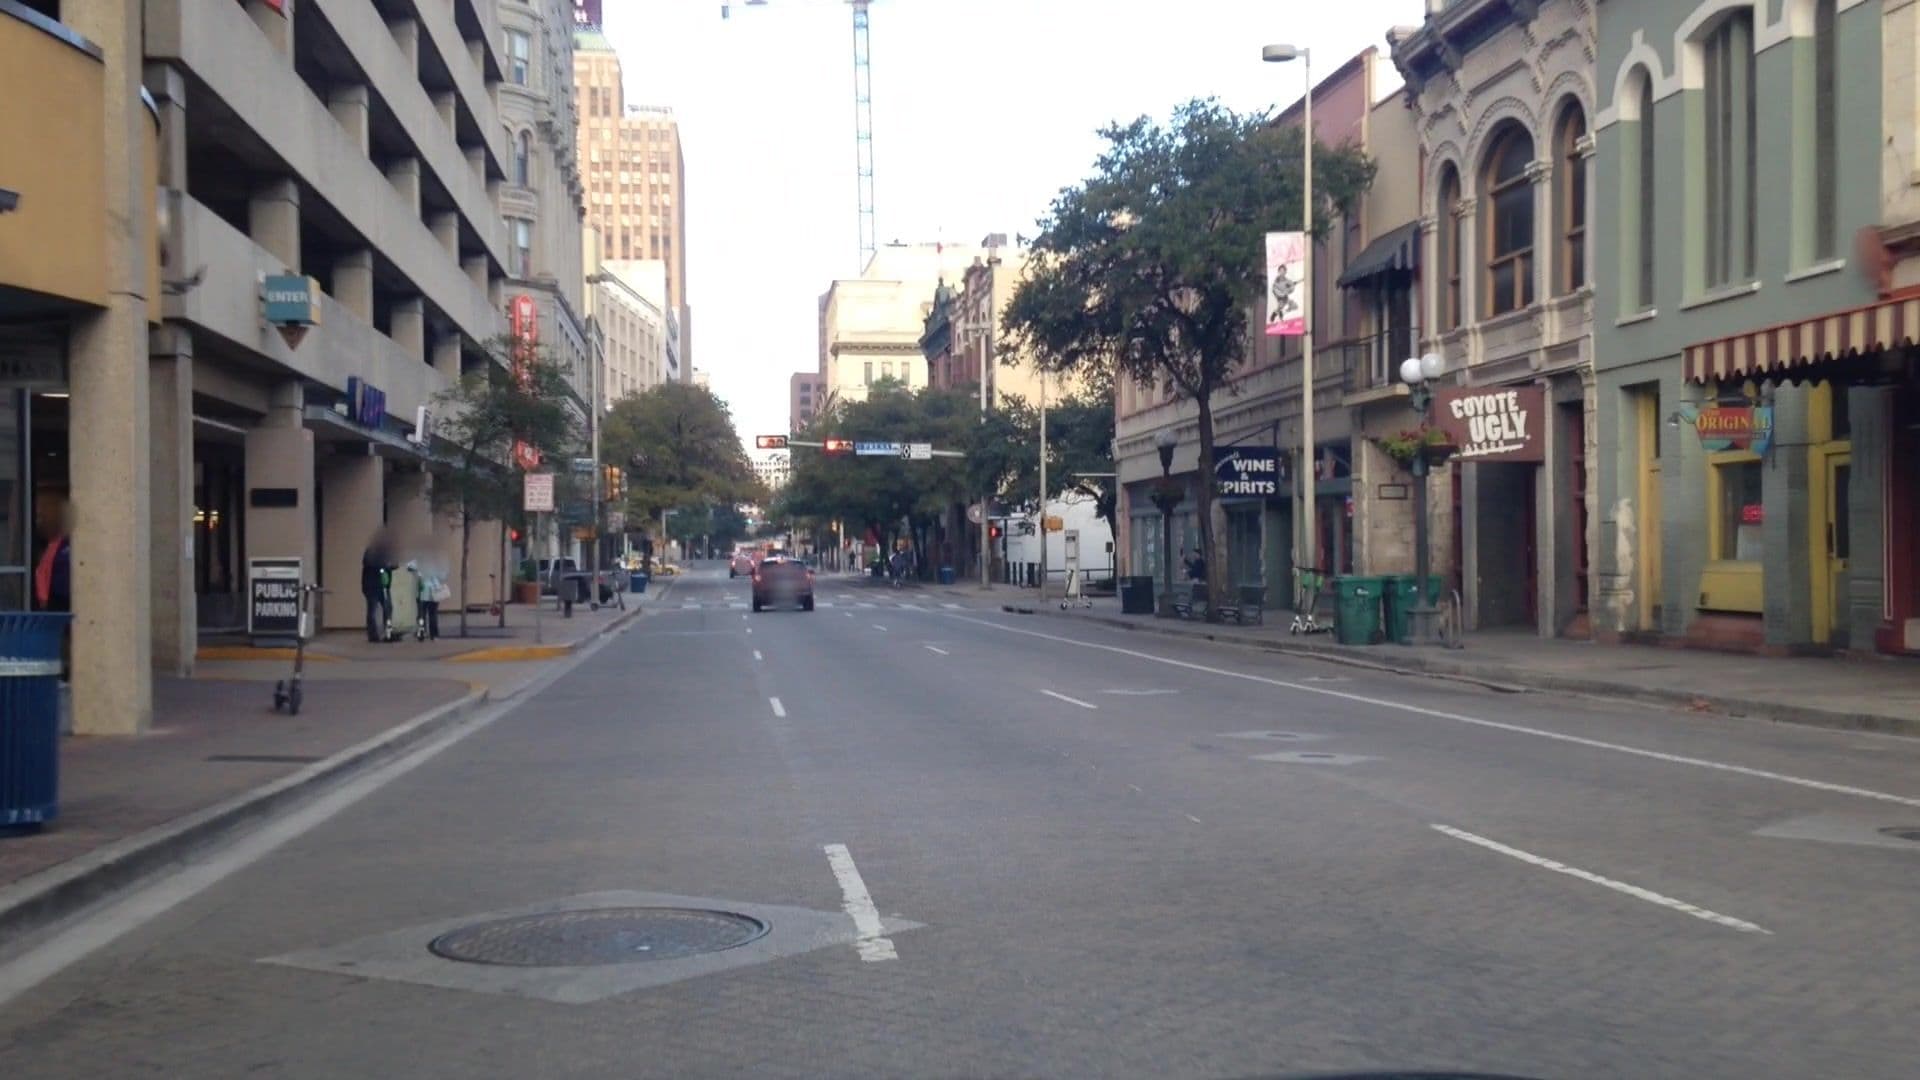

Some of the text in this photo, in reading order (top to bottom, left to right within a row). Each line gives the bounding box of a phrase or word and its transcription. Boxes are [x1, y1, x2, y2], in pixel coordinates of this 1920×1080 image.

[267, 290, 308, 303] ENTER
[1450, 391, 1519, 418] COYOTE
[1695, 414, 1770, 432] ORIGINAL
[1232, 459, 1275, 472] WINE
[1240, 472, 1249, 481] &
[1217, 481, 1276, 494] PIRITS
[255, 583, 297, 598] PUBLIC
[255, 602, 297, 617] PARKING
